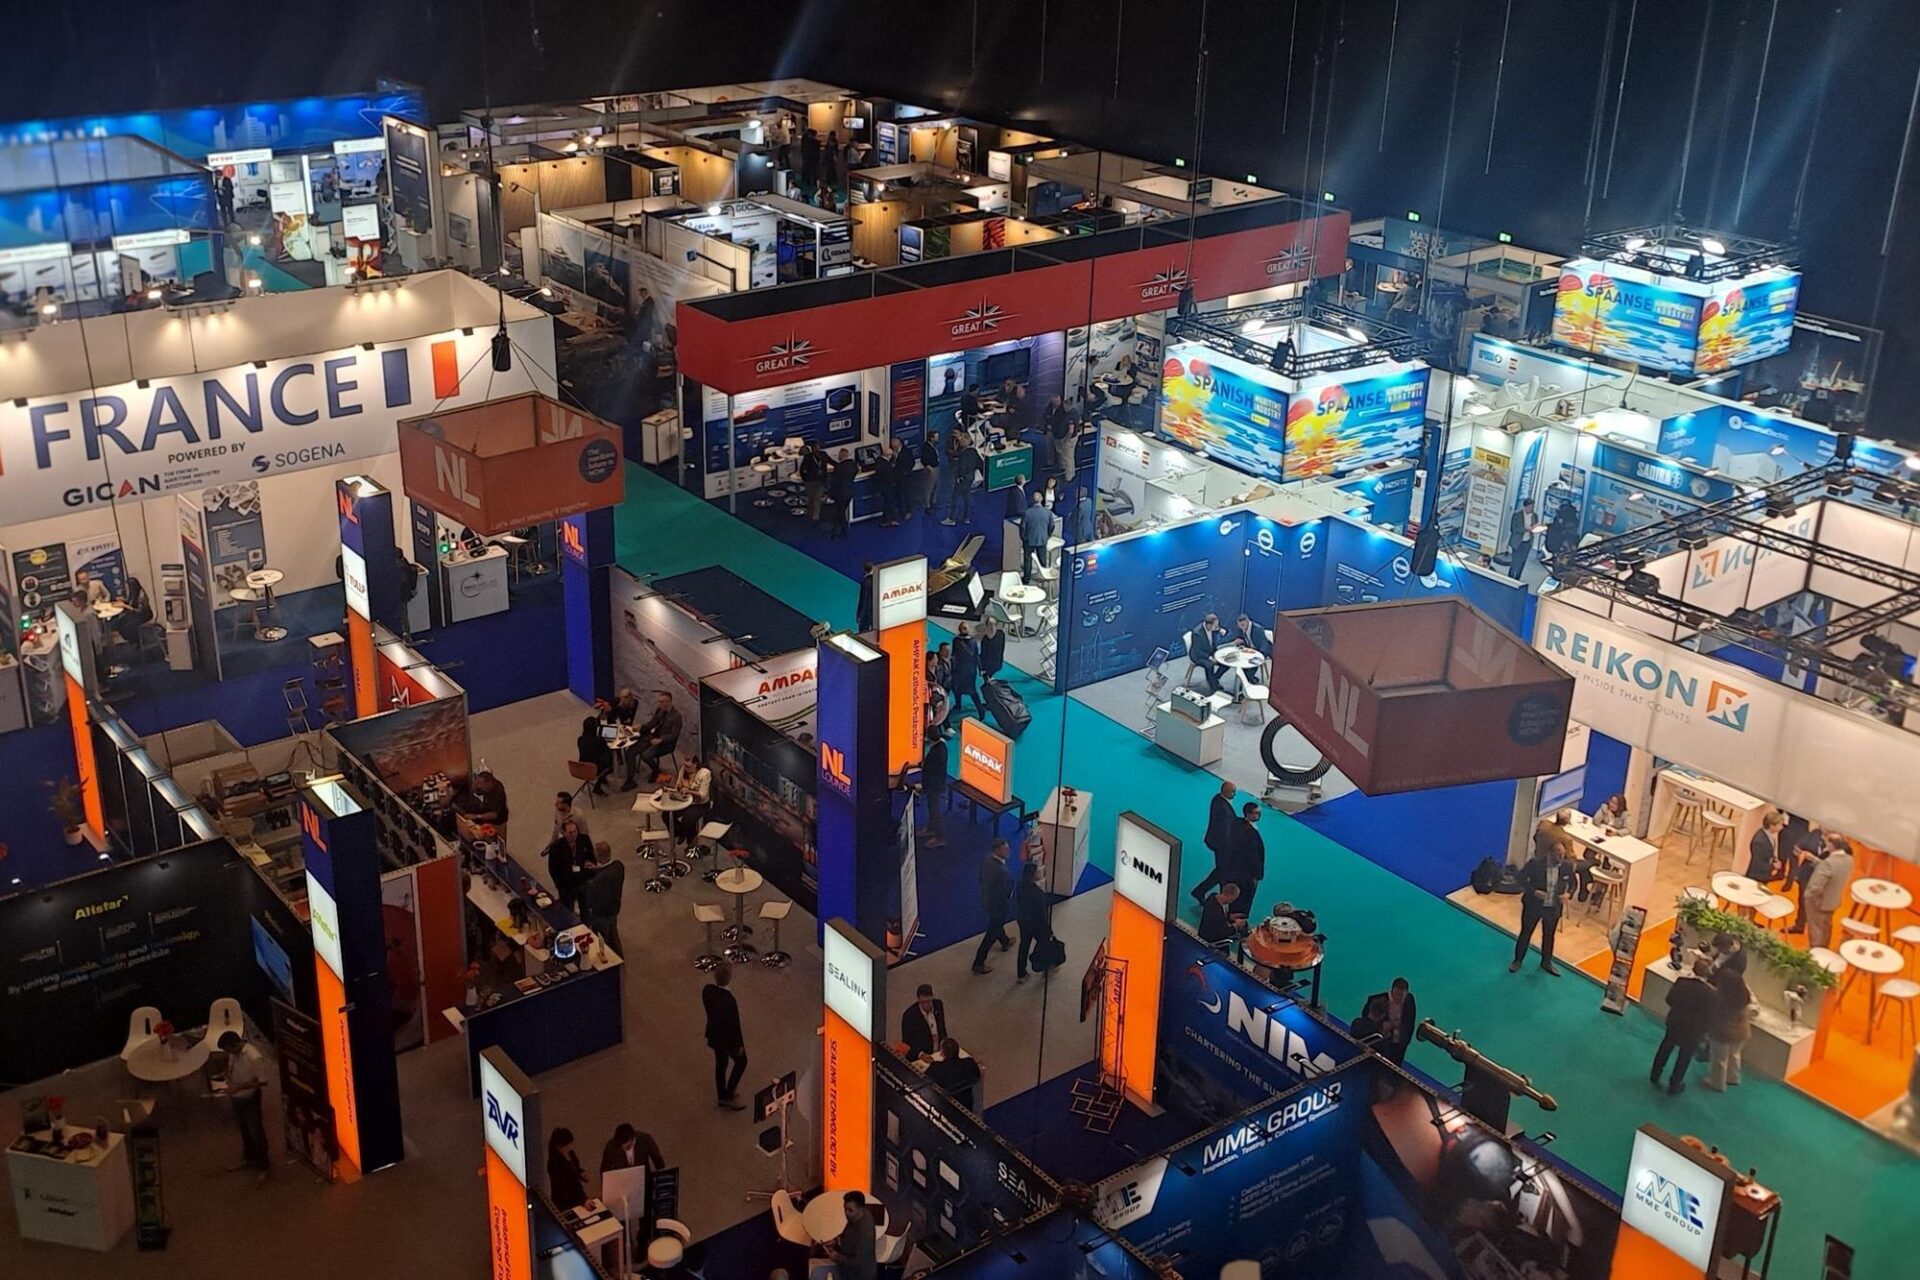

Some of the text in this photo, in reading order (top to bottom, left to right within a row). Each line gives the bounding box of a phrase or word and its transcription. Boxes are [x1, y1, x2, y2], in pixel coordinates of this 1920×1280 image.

[1267, 260, 1291, 273] GREAT
[1141, 285, 1168, 298] GREAT
[1586, 285, 1652, 312] SPAANSE
[1721, 293, 1768, 316] SPAANSE
[951, 321, 981, 335] GREAT
[756, 357, 789, 373] GREAT
[1193, 374, 1253, 406] SPANISH
[1317, 391, 1383, 416] SPAANSE
[30, 355, 364, 469] FRANCE
[168, 442, 246, 464] POWERED BY
[275, 442, 346, 468] SOGENA
[63, 474, 161, 507] GICAN
[434, 445, 481, 509] NL
[339, 490, 358, 525] NL
[564, 521, 584, 553] NL
[882, 583, 922, 601] AMPAK
[1545, 623, 1698, 707] REIKON
[758, 668, 818, 695] AMPA
[1315, 657, 1369, 758] NL
[1582, 674, 1615, 694] INSIDE
[1619, 687, 1643, 705] THAT
[1647, 700, 1690, 724] COUNTS
[822, 742, 851, 785] NL
[964, 745, 1003, 774] AMPAK
[821, 770, 851, 797] LOUNGE
[301, 801, 327, 853] NL
[1132, 856, 1162, 884] NIM
[74, 896, 126, 920] Allstar
[828, 962, 868, 1002] SEALINK
[1185, 1026, 1281, 1096] CHARTERING THE SU
[1203, 1081, 1342, 1165] MME GROUP
[831, 1161, 838, 1178] BV
[1202, 1154, 1239, 1176] Inspection,
[998, 1161, 1056, 1212] SEALIN
[1635, 1192, 1660, 1212] MME
[1665, 1211, 1701, 1236] GROUP
